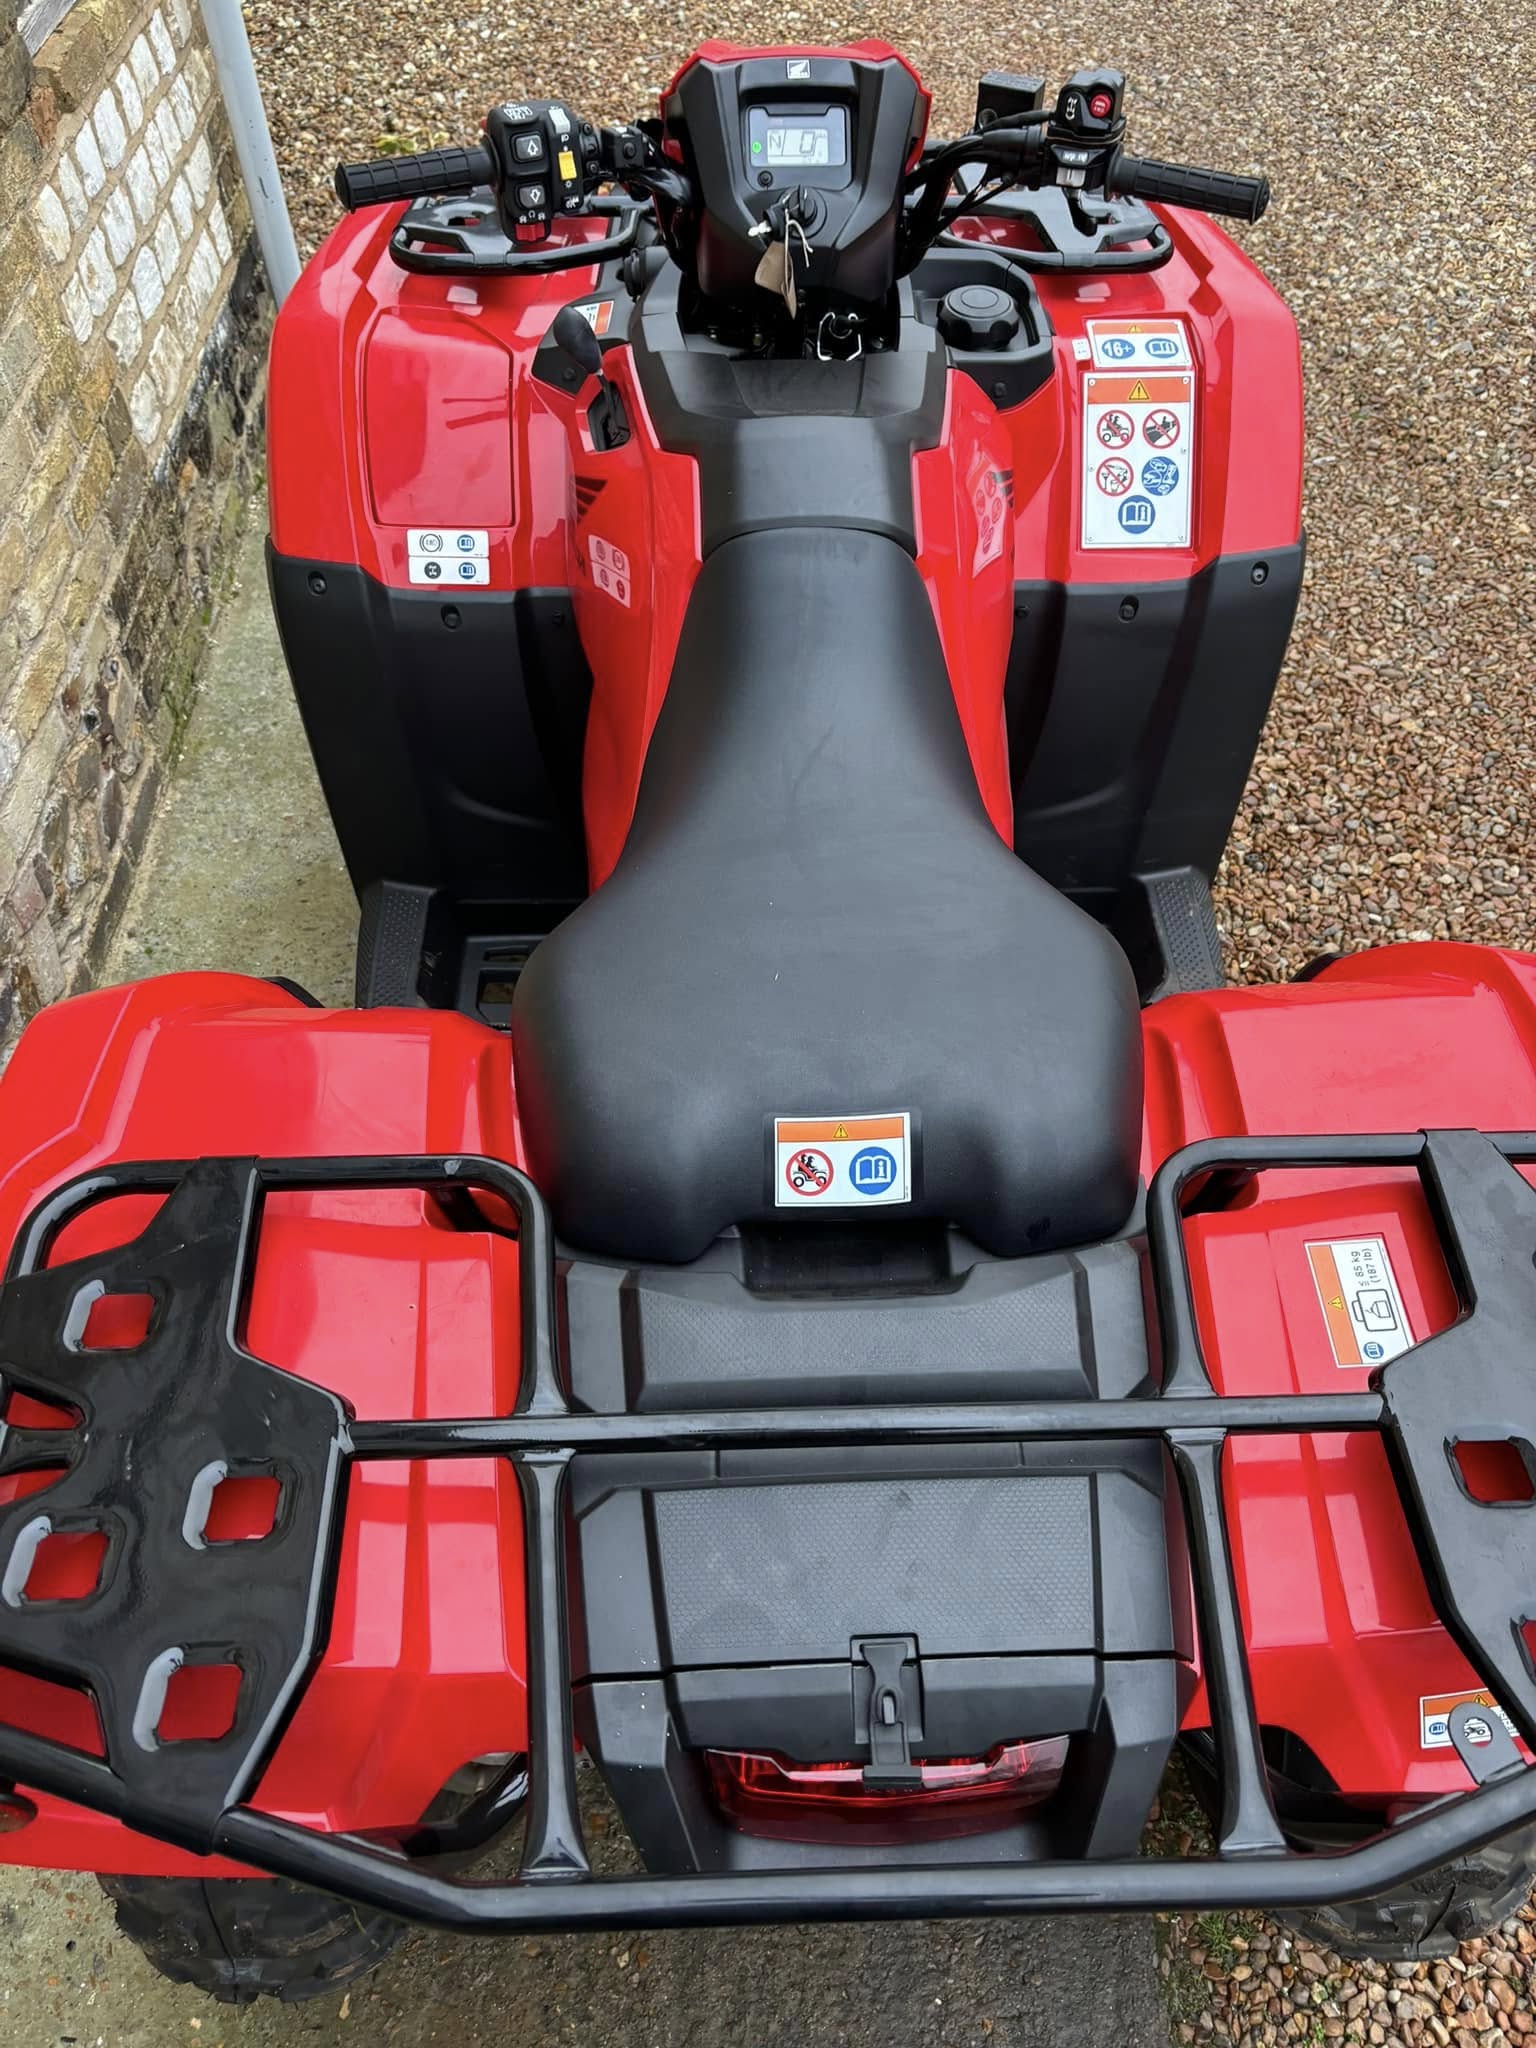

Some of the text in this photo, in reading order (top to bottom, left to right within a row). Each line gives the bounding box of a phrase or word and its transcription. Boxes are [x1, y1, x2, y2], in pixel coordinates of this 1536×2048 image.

[769, 131, 816, 153] N 0
[1104, 341, 1132, 358] 16+
[1351, 1251, 1361, 1263] kg
[1361, 1248, 1381, 1283] (187 lb)
[1353, 1265, 1365, 1277] 85
